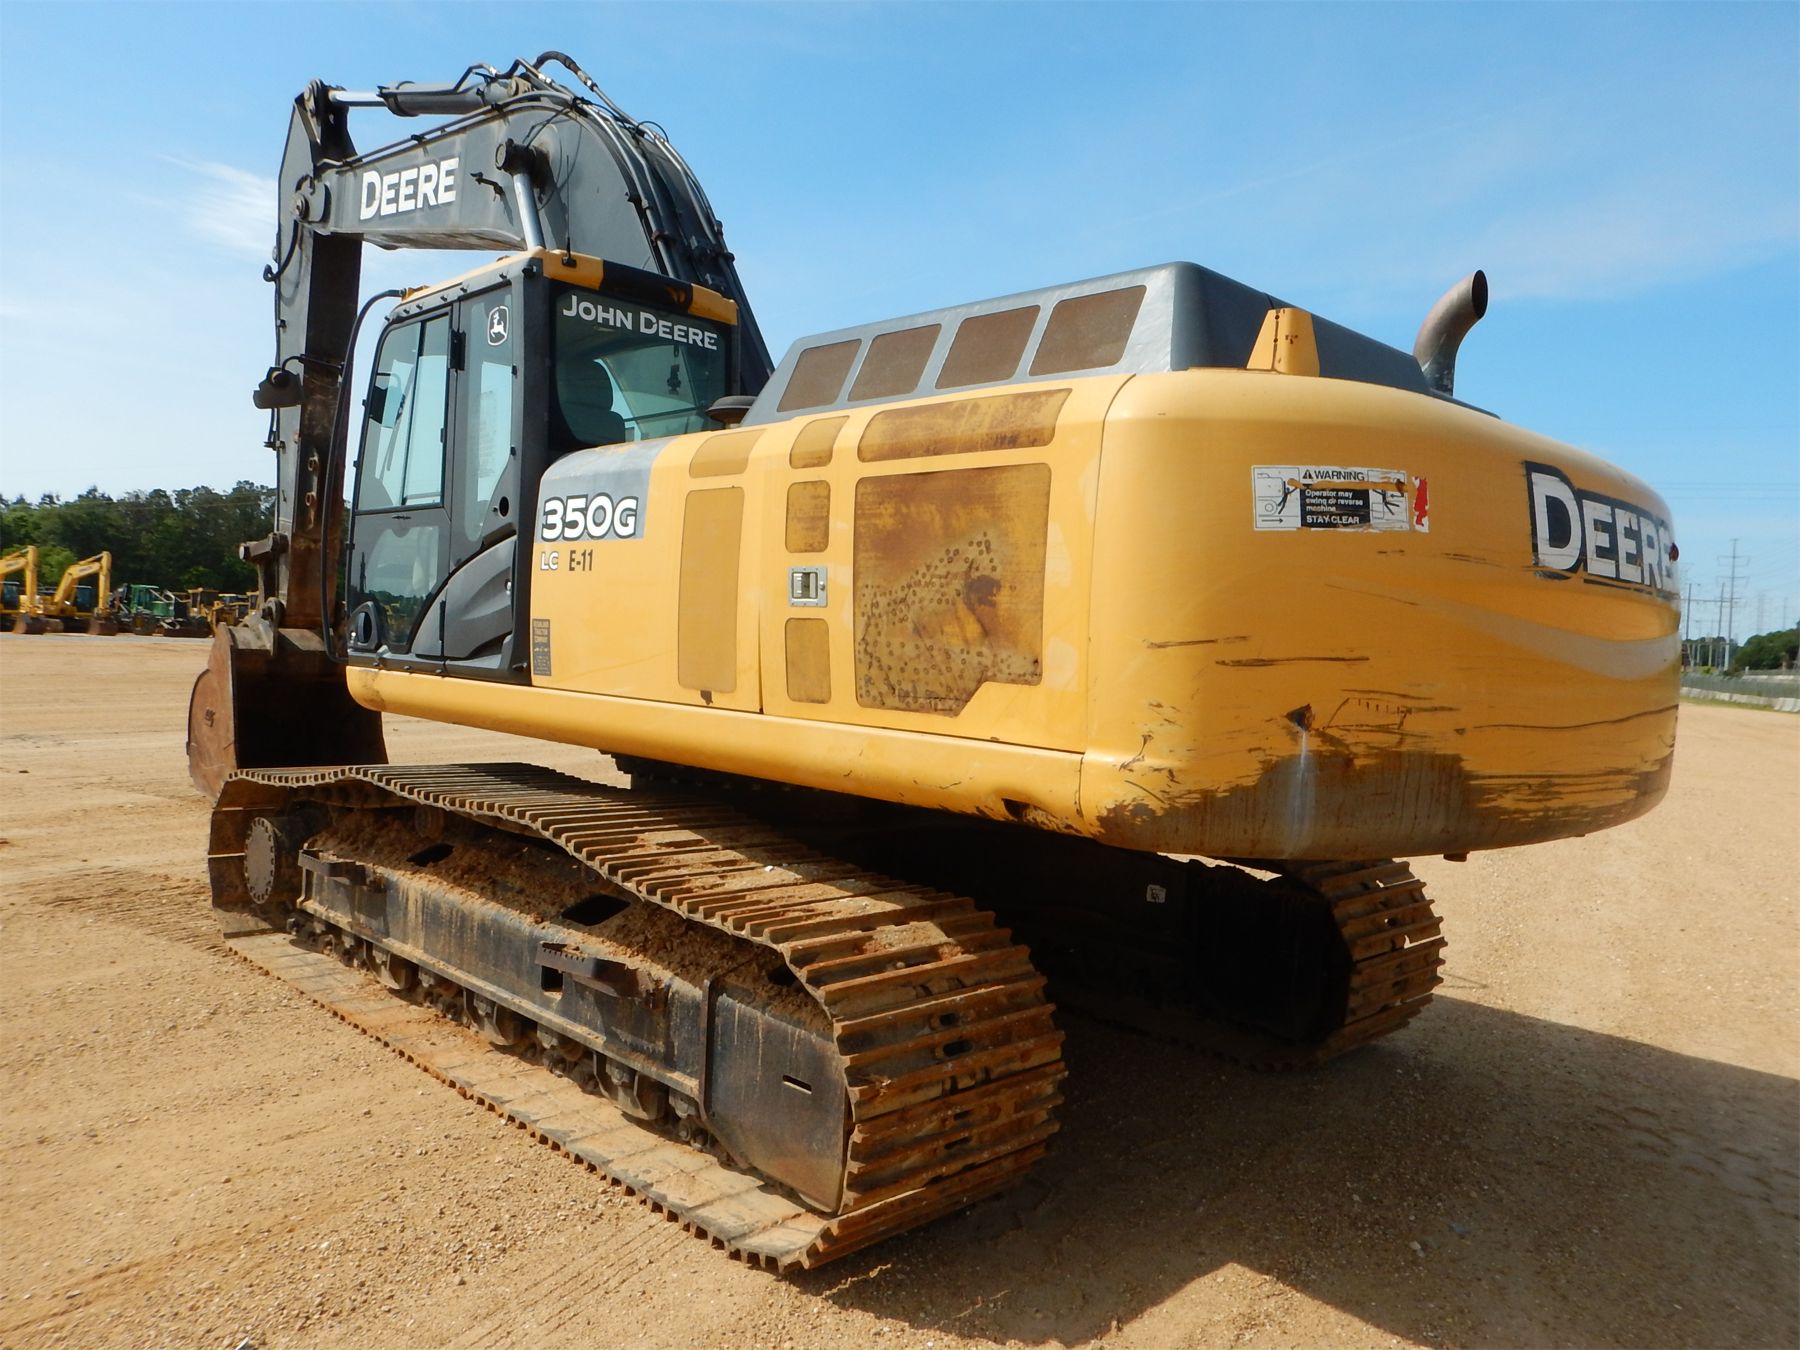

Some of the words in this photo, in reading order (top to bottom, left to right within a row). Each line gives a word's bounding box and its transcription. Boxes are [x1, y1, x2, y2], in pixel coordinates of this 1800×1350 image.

[360, 157, 460, 220] DEERE
[562, 294, 633, 330] JOHN
[639, 311, 718, 351] DEERE
[1313, 469, 1365, 481] WARNING
[1305, 489, 1337, 498] Operator
[1338, 490, 1353, 498] may
[1337, 498, 1364, 506] reverse
[541, 492, 639, 542] 350G
[1306, 515, 1330, 524] STAY
[1331, 515, 1360, 524] CLEAR
[1526, 463, 1679, 596] DEERE
[540, 551, 559, 571] LC
[568, 549, 593, 572] E-11
